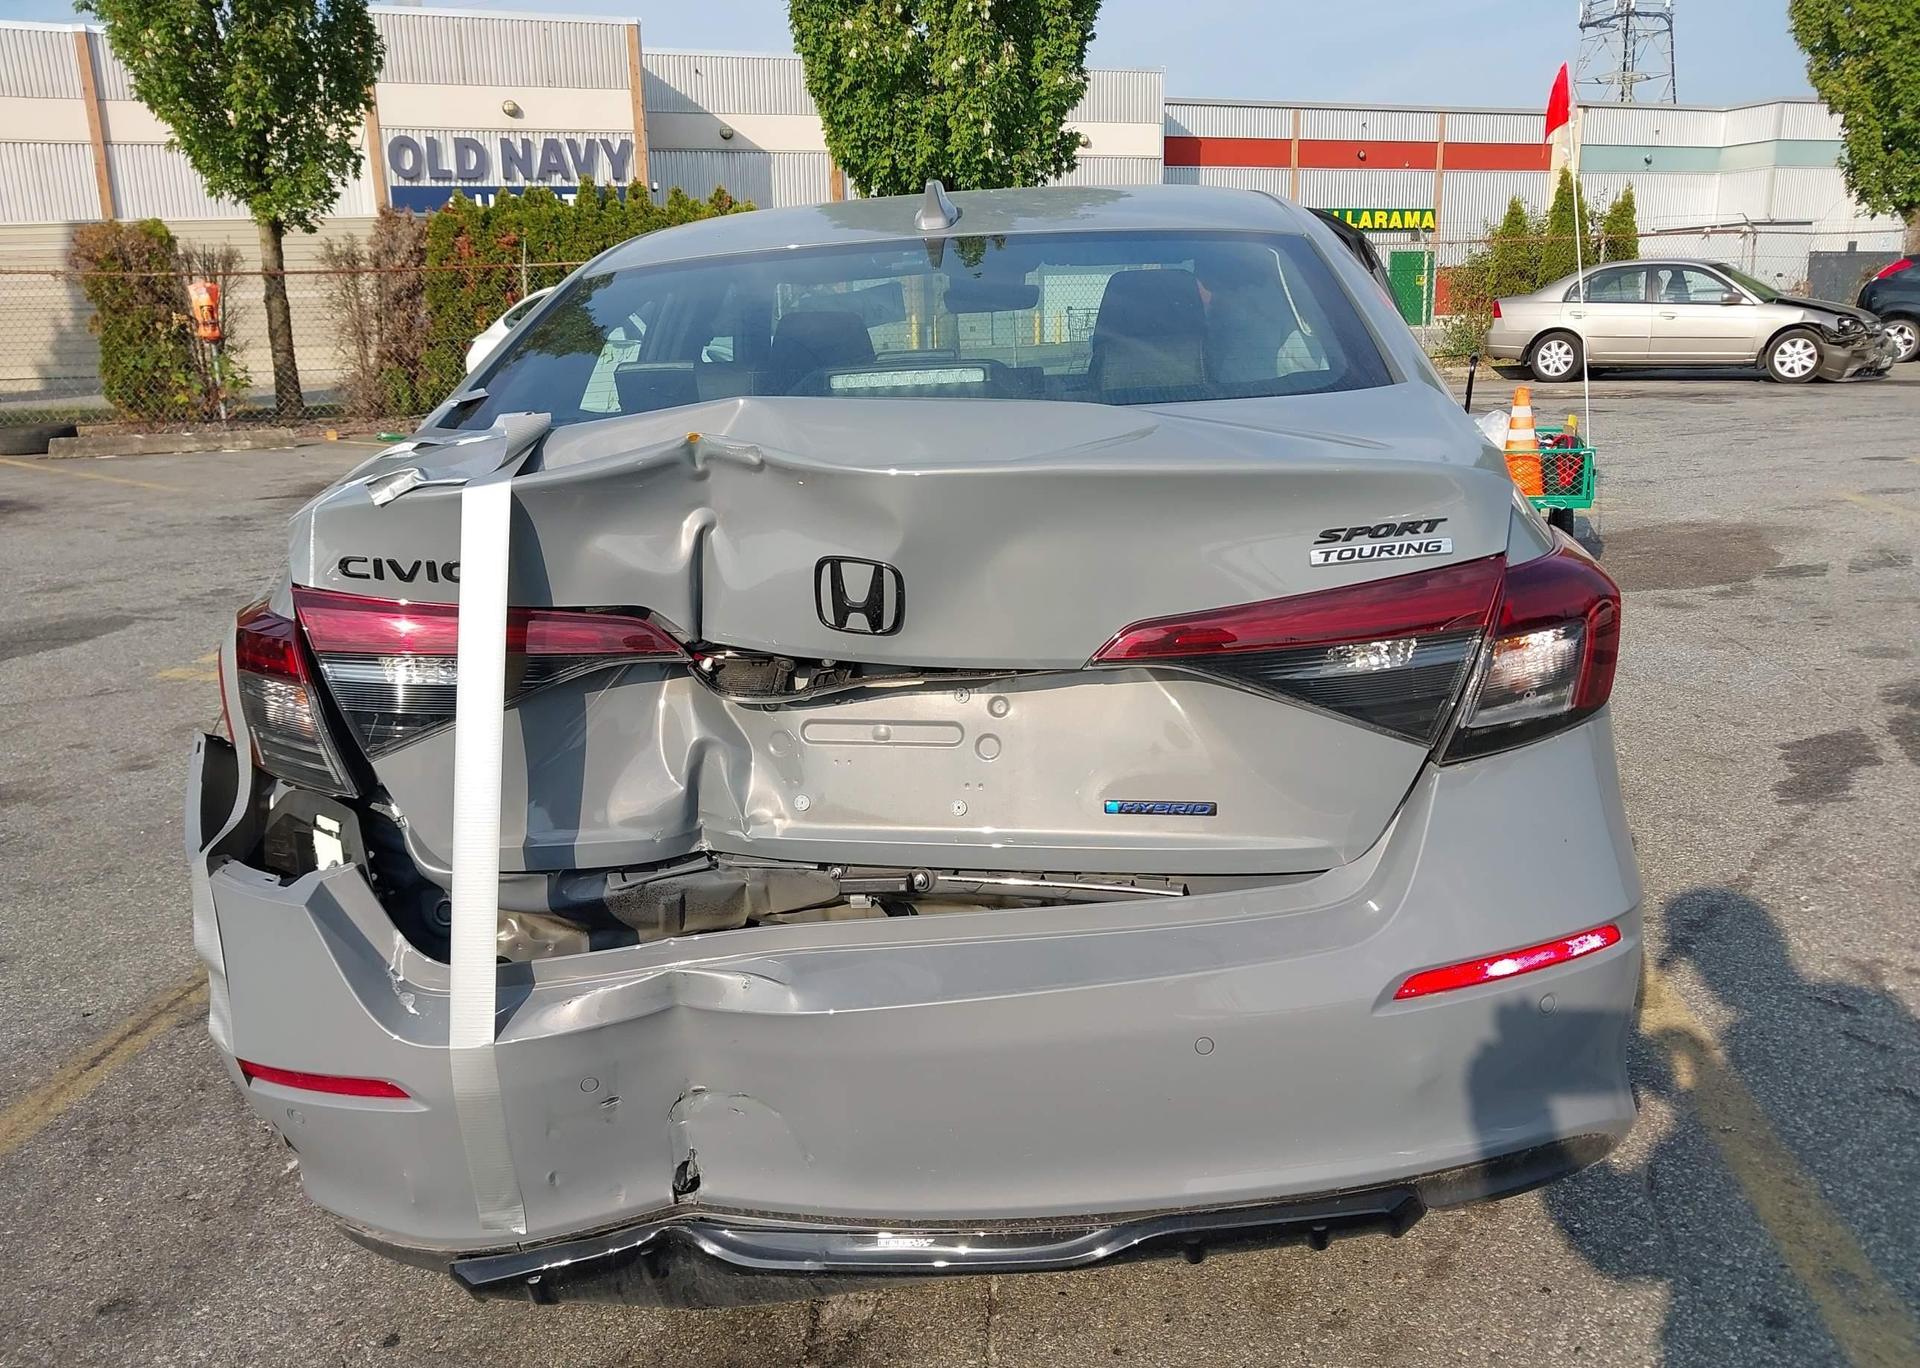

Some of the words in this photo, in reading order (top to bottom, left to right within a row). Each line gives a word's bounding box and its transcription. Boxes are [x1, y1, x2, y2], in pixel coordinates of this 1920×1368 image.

[388, 135, 487, 181] OLD
[500, 137, 632, 181] NAVY
[1313, 517, 1448, 545] SPORT
[1318, 540, 1443, 563] TOURING
[1120, 802, 1212, 815] HYBRID
